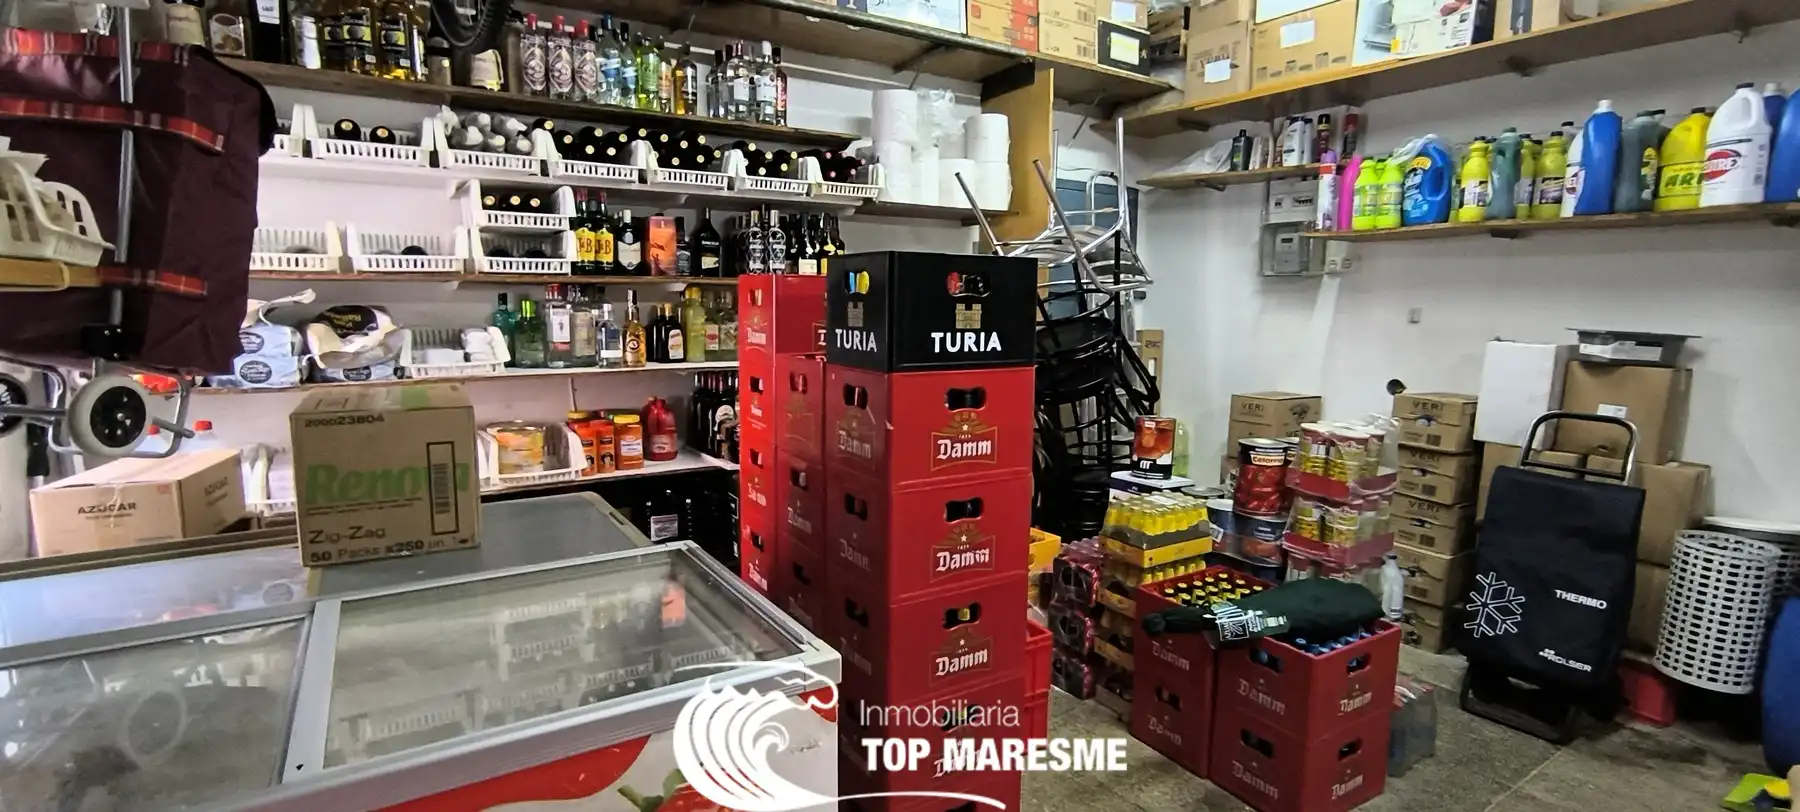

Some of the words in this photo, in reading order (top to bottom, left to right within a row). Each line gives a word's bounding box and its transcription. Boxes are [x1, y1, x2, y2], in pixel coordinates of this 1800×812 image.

[835, 328, 877, 352] TURIA
[931, 331, 1002, 353] TURIA
[1413, 401, 1444, 411] VERI
[838, 430, 871, 459] Damm
[936, 439, 992, 460] Damm
[308, 526, 386, 544] Zig-Zag
[310, 551, 332, 562] 50
[935, 547, 990, 572] Damm
[1554, 589, 1607, 610] THERMO
[935, 648, 988, 677] Damm
[1237, 679, 1286, 715] Damm
[1232, 760, 1279, 800] Damm
